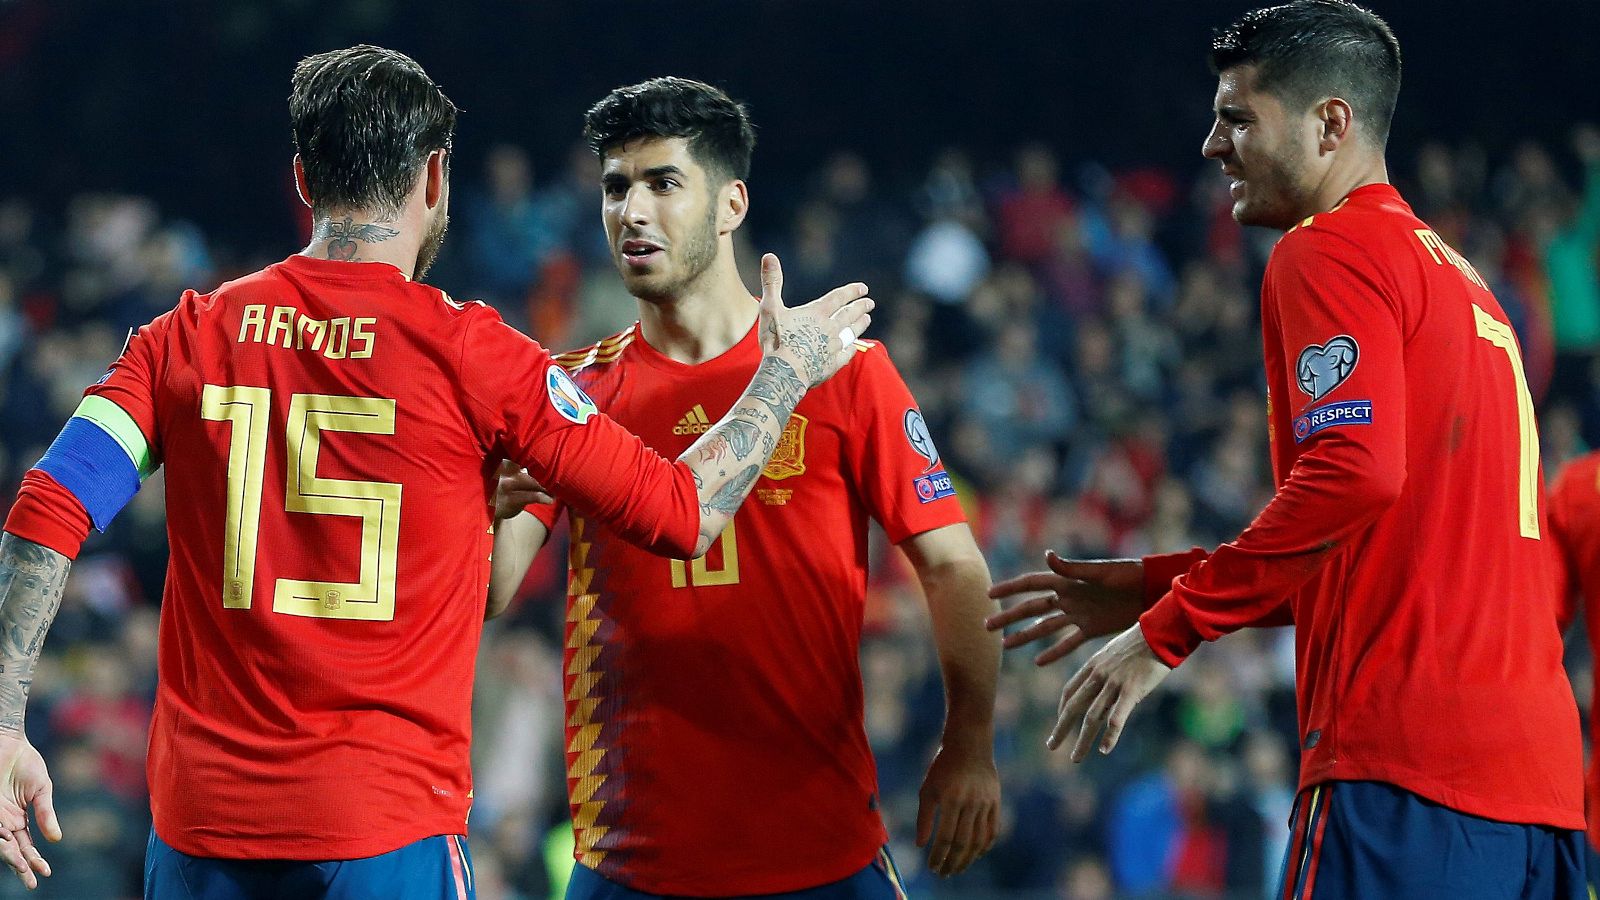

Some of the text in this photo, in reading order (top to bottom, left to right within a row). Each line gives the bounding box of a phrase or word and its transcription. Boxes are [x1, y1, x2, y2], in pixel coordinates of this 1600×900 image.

[238, 304, 376, 359] RAMOS
[672, 422, 714, 435] adida
[1312, 407, 1371, 427] RESPECT
[201, 384, 403, 621] 15
